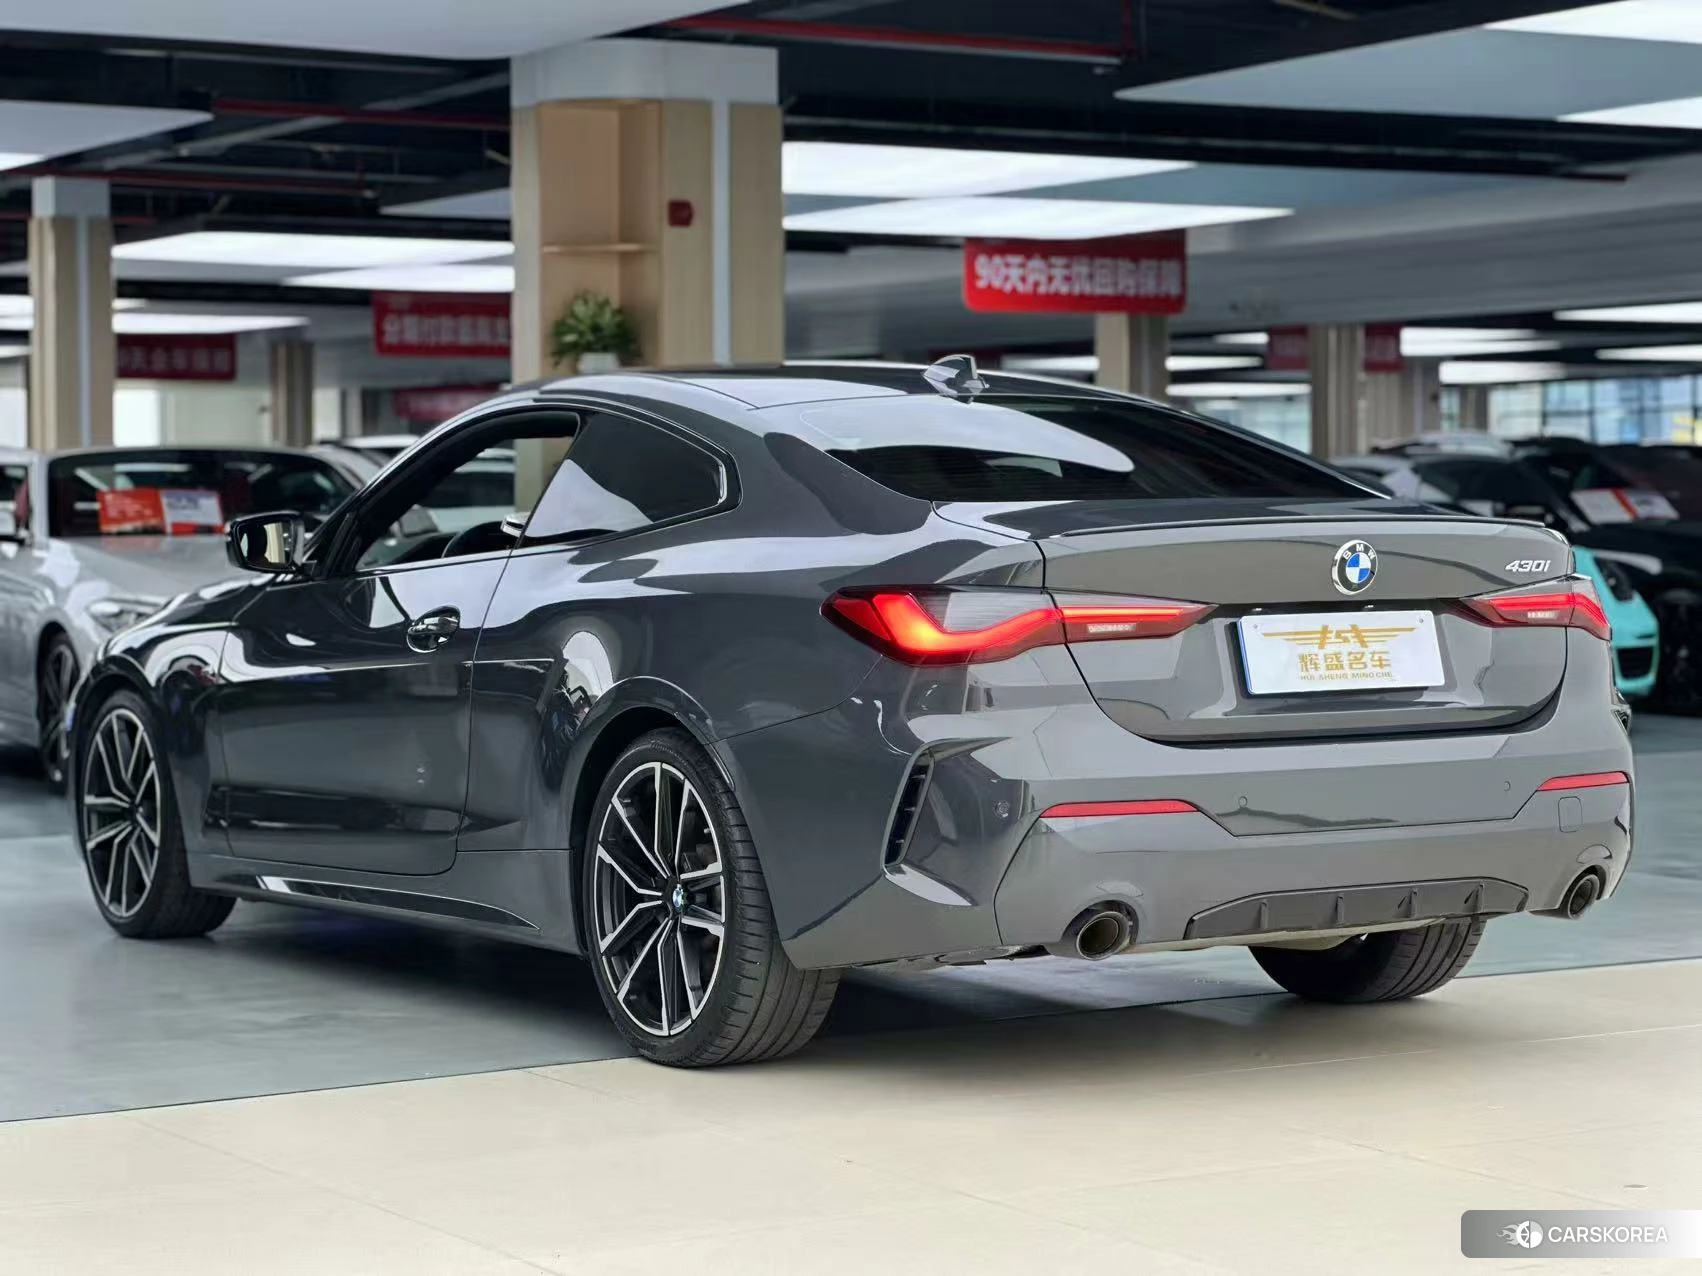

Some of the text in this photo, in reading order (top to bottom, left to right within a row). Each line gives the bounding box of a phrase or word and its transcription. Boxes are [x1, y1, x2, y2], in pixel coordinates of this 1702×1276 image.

[1342, 543, 1376, 560] BMW
[1298, 650, 1392, 672] 辉盛名车
[1319, 671, 1348, 681] SHENG
